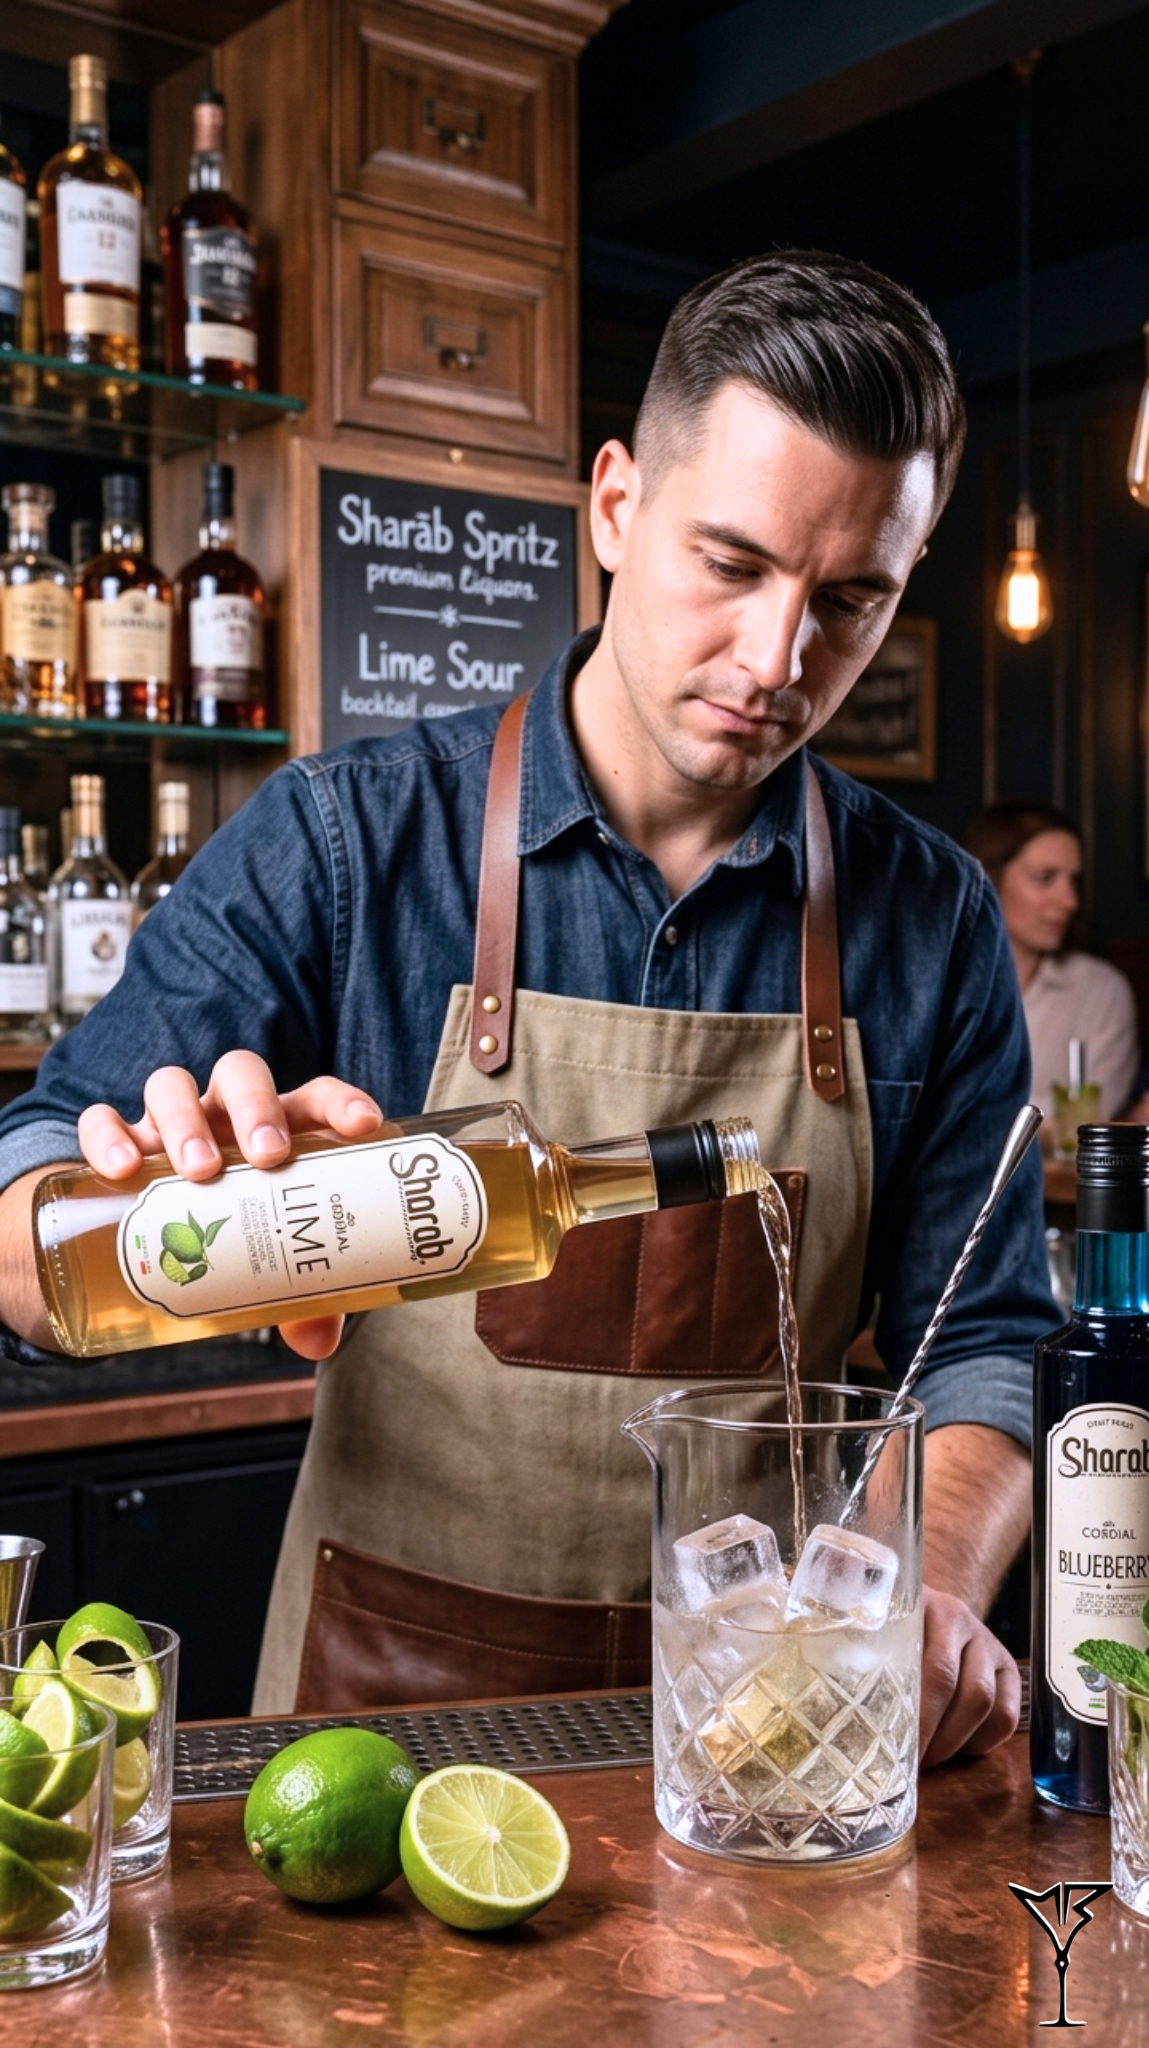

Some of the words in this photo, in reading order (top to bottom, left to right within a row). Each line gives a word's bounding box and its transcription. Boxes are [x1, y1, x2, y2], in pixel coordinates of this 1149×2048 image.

[337, 493, 454, 554] Sharāb
[463, 510, 559, 574] Spritz
[358, 632, 436, 686] Lime
[446, 640, 524, 692] Sour
[282, 1184, 331, 1275] LIME
